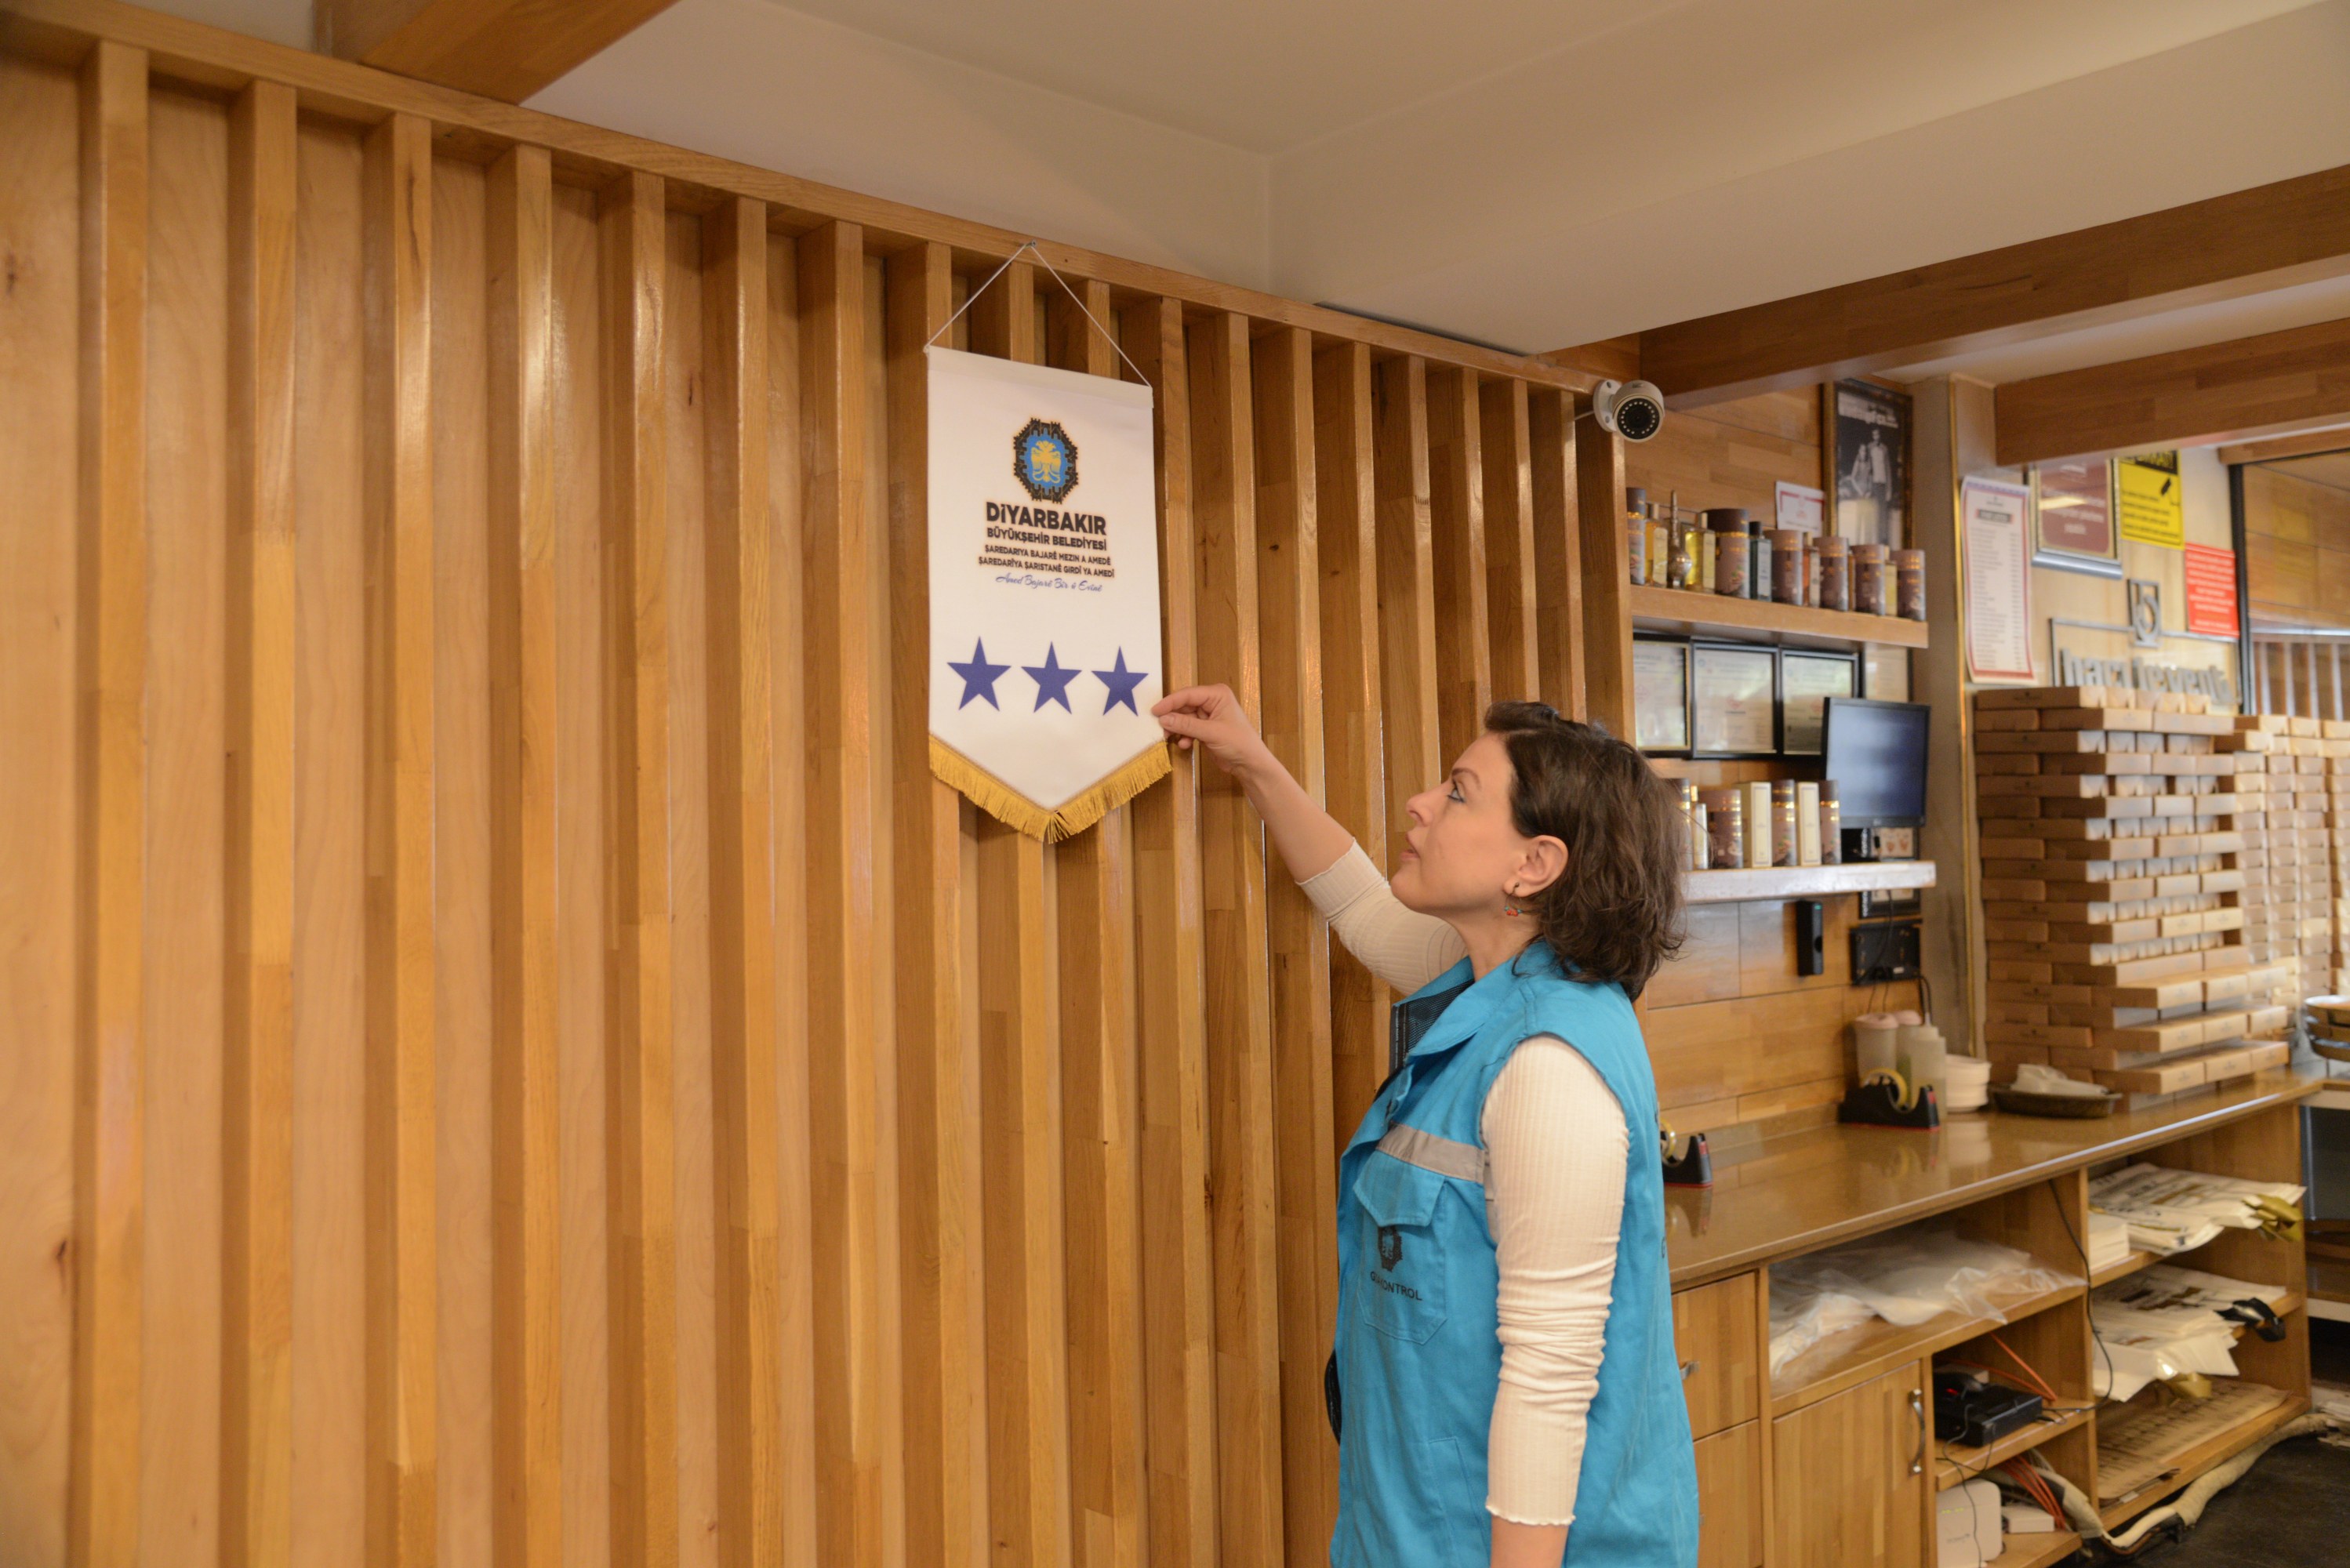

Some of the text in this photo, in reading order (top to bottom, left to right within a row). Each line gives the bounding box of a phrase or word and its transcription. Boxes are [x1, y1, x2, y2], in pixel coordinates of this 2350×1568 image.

[986, 501, 1107, 535] DİYARBAKIR
[987, 527, 1107, 551] BÜYÜKŞEHİR BELEDİYESİ
[1030, 550, 1057, 560] BAJARÊ
[1059, 553, 1080, 562] MEZIN
[1088, 556, 1111, 566] AMEDÊ
[995, 572, 1024, 584] Amed
[1083, 568, 1092, 576] YA
